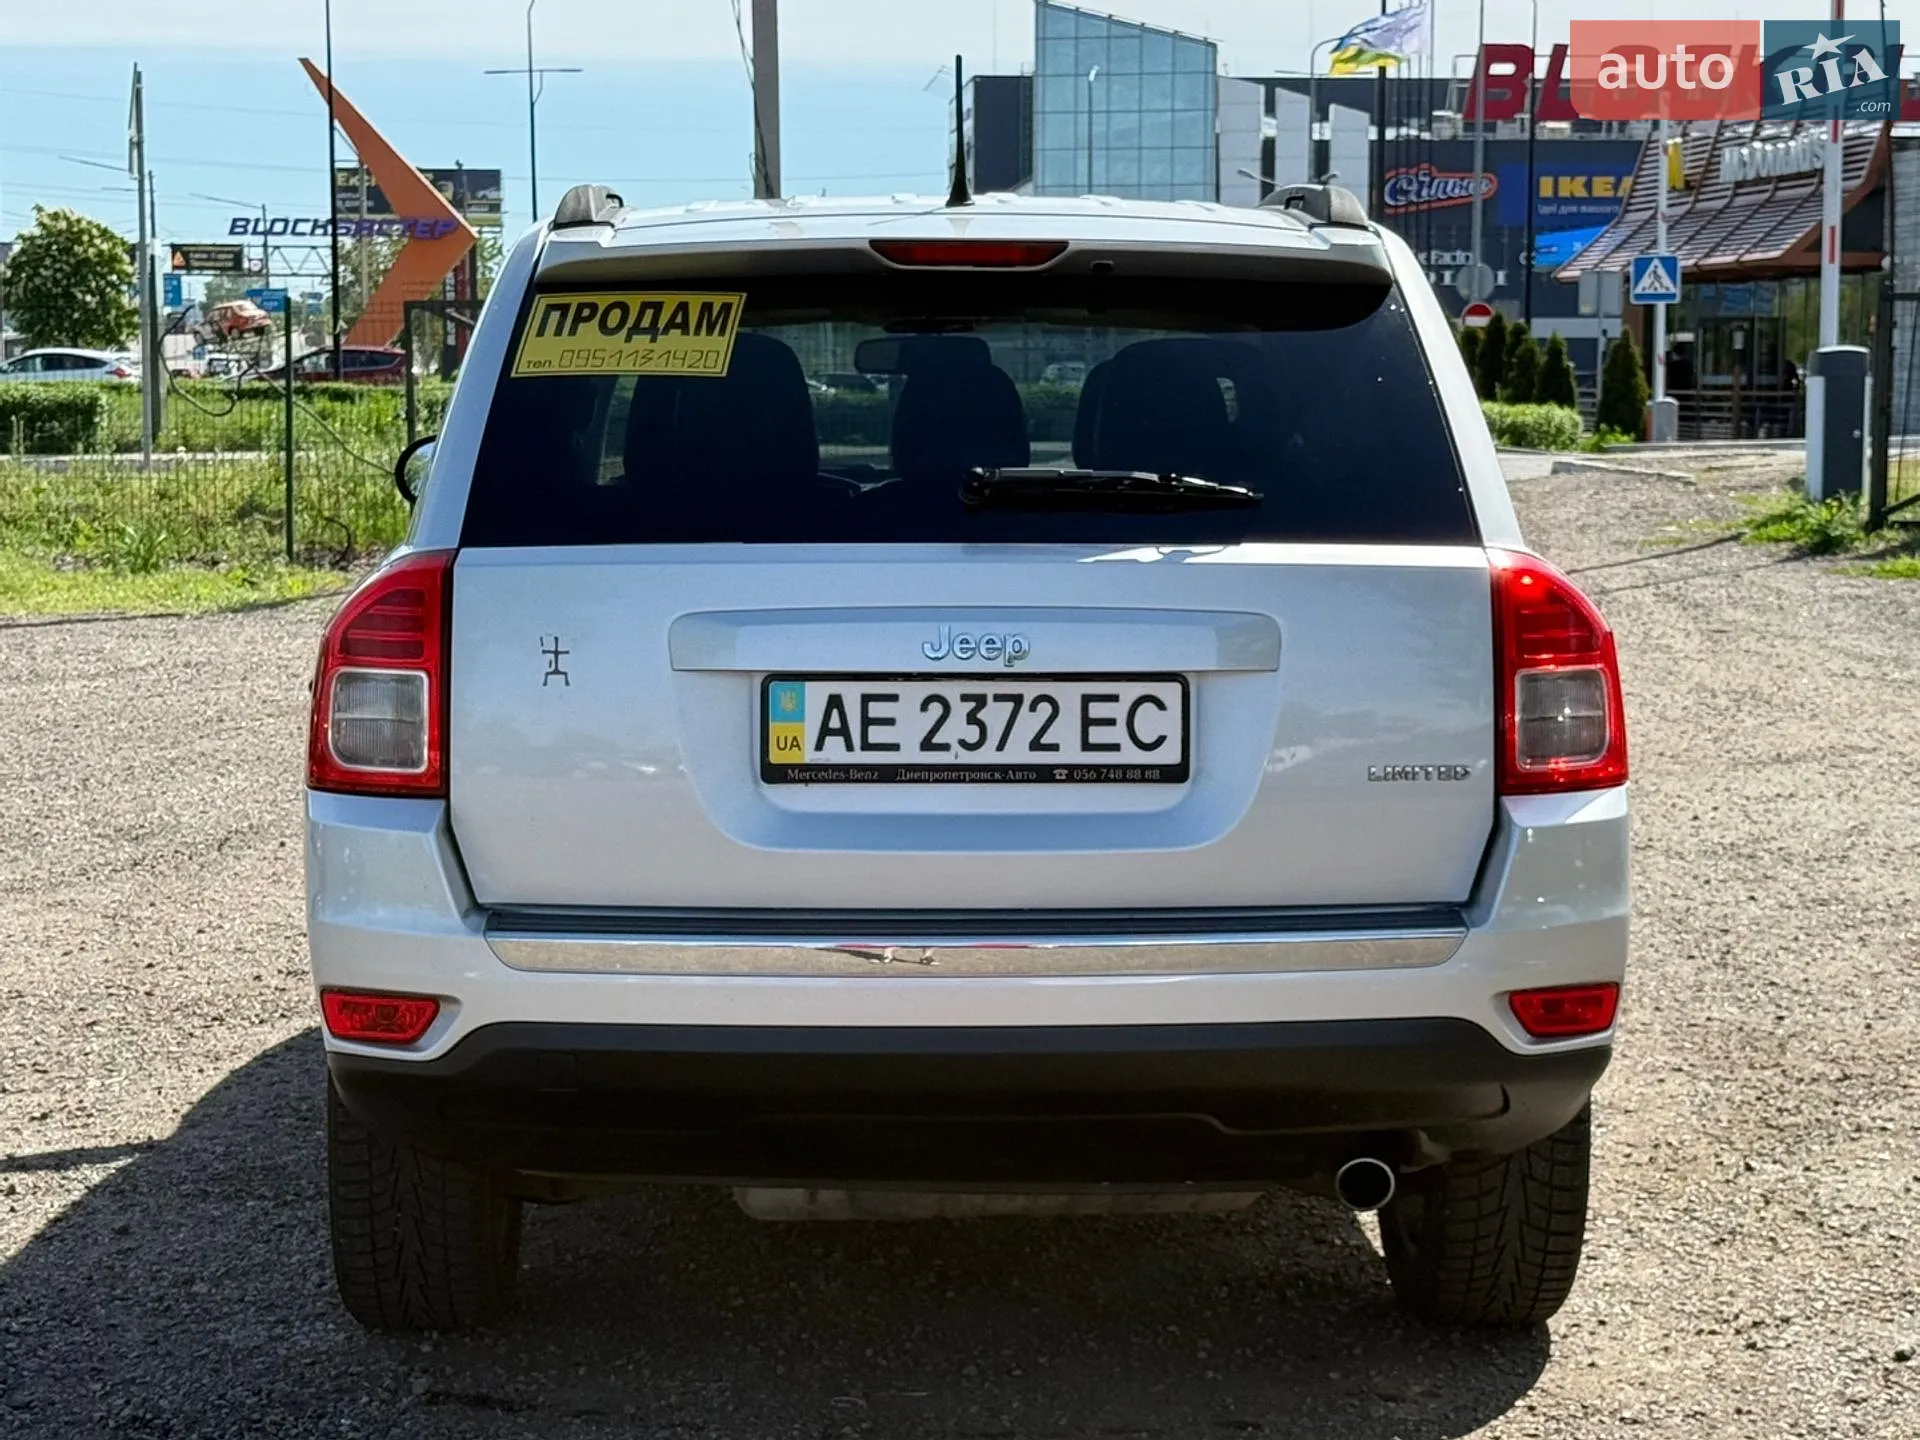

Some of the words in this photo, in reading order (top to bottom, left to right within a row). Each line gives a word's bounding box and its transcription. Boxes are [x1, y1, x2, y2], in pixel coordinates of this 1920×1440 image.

[535, 300, 732, 344] ПРОДАМ
[558, 348, 721, 369] 0951131420
[921, 624, 1031, 667] Jeep
[813, 693, 901, 753] AE
[919, 693, 1060, 753] 2372
[1080, 693, 1168, 753] EC
[776, 736, 801, 752] UA
[786, 768, 880, 781] Mercedes-Benz
[1367, 765, 1471, 782] LIMITED
